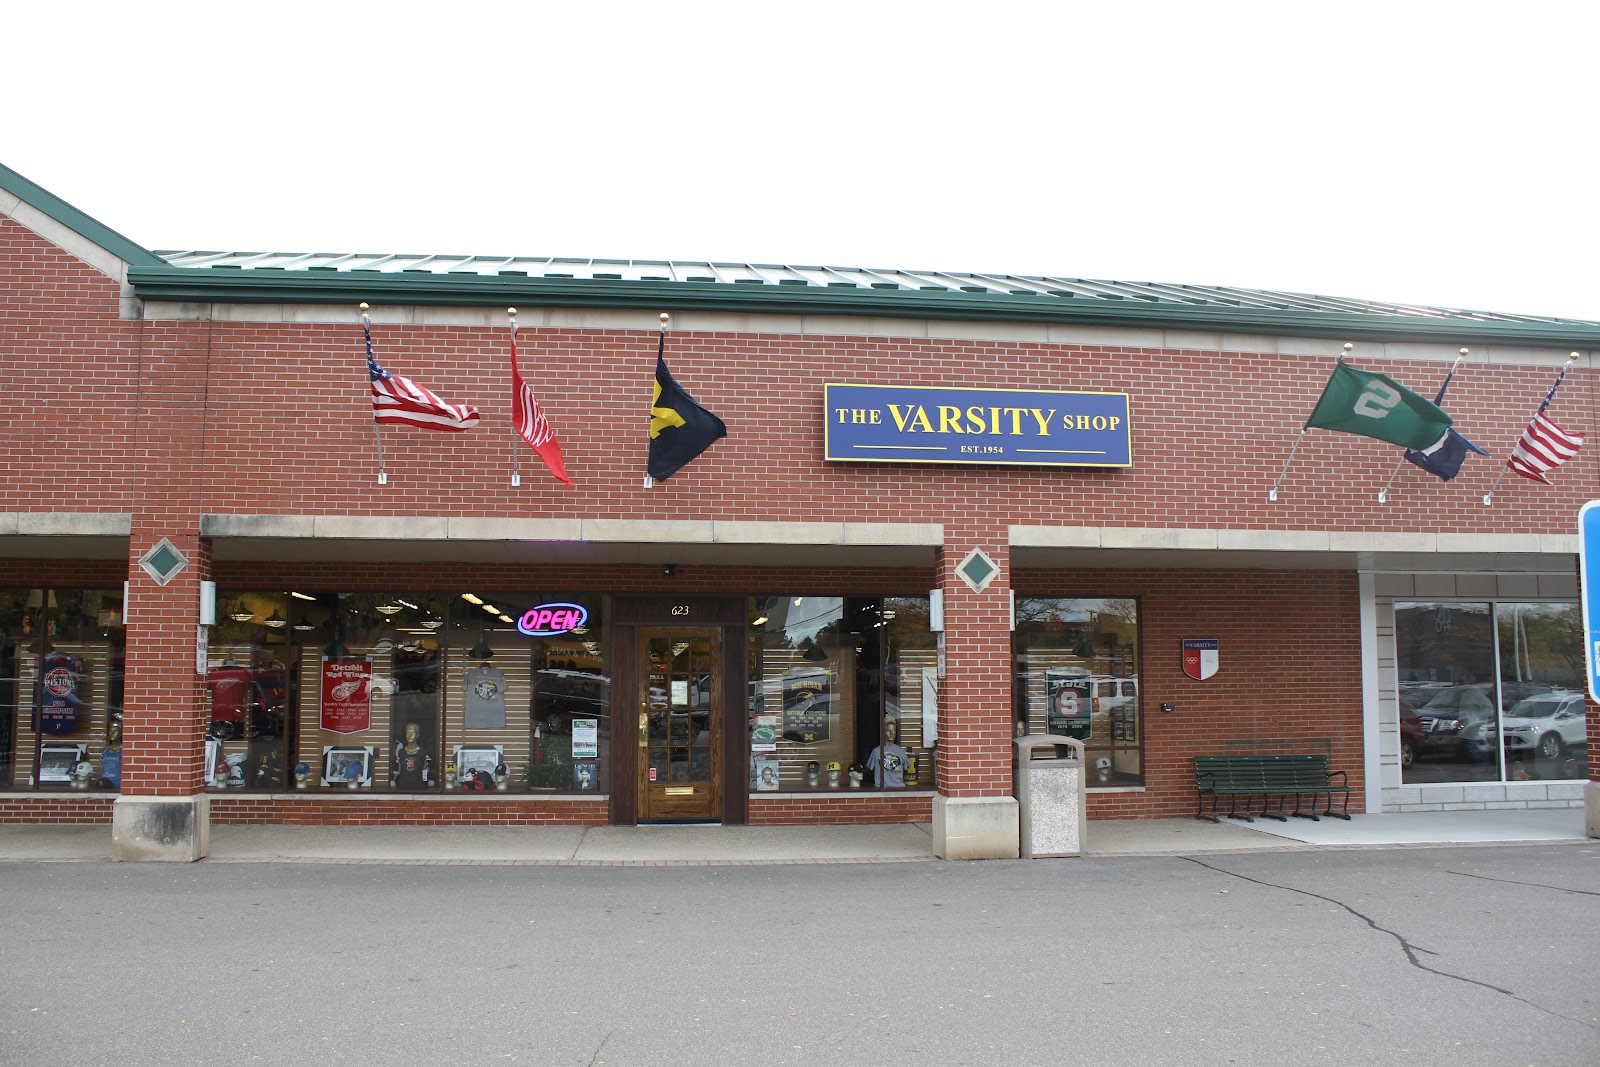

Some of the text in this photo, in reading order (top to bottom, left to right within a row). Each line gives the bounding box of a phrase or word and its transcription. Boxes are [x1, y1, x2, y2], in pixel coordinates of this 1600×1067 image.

[835, 403, 1121, 436] THE VARSITY SHOP
[960, 445, 1003, 454] EST.1954
[671, 605, 689, 616] 623
[521, 610, 580, 630] OPEN
[326, 671, 343, 679] Red
[44, 678, 75, 688] PISTONS
[791, 680, 823, 692] MICHIGAN
[1050, 679, 1087, 689] State
[1060, 691, 1078, 715] S
